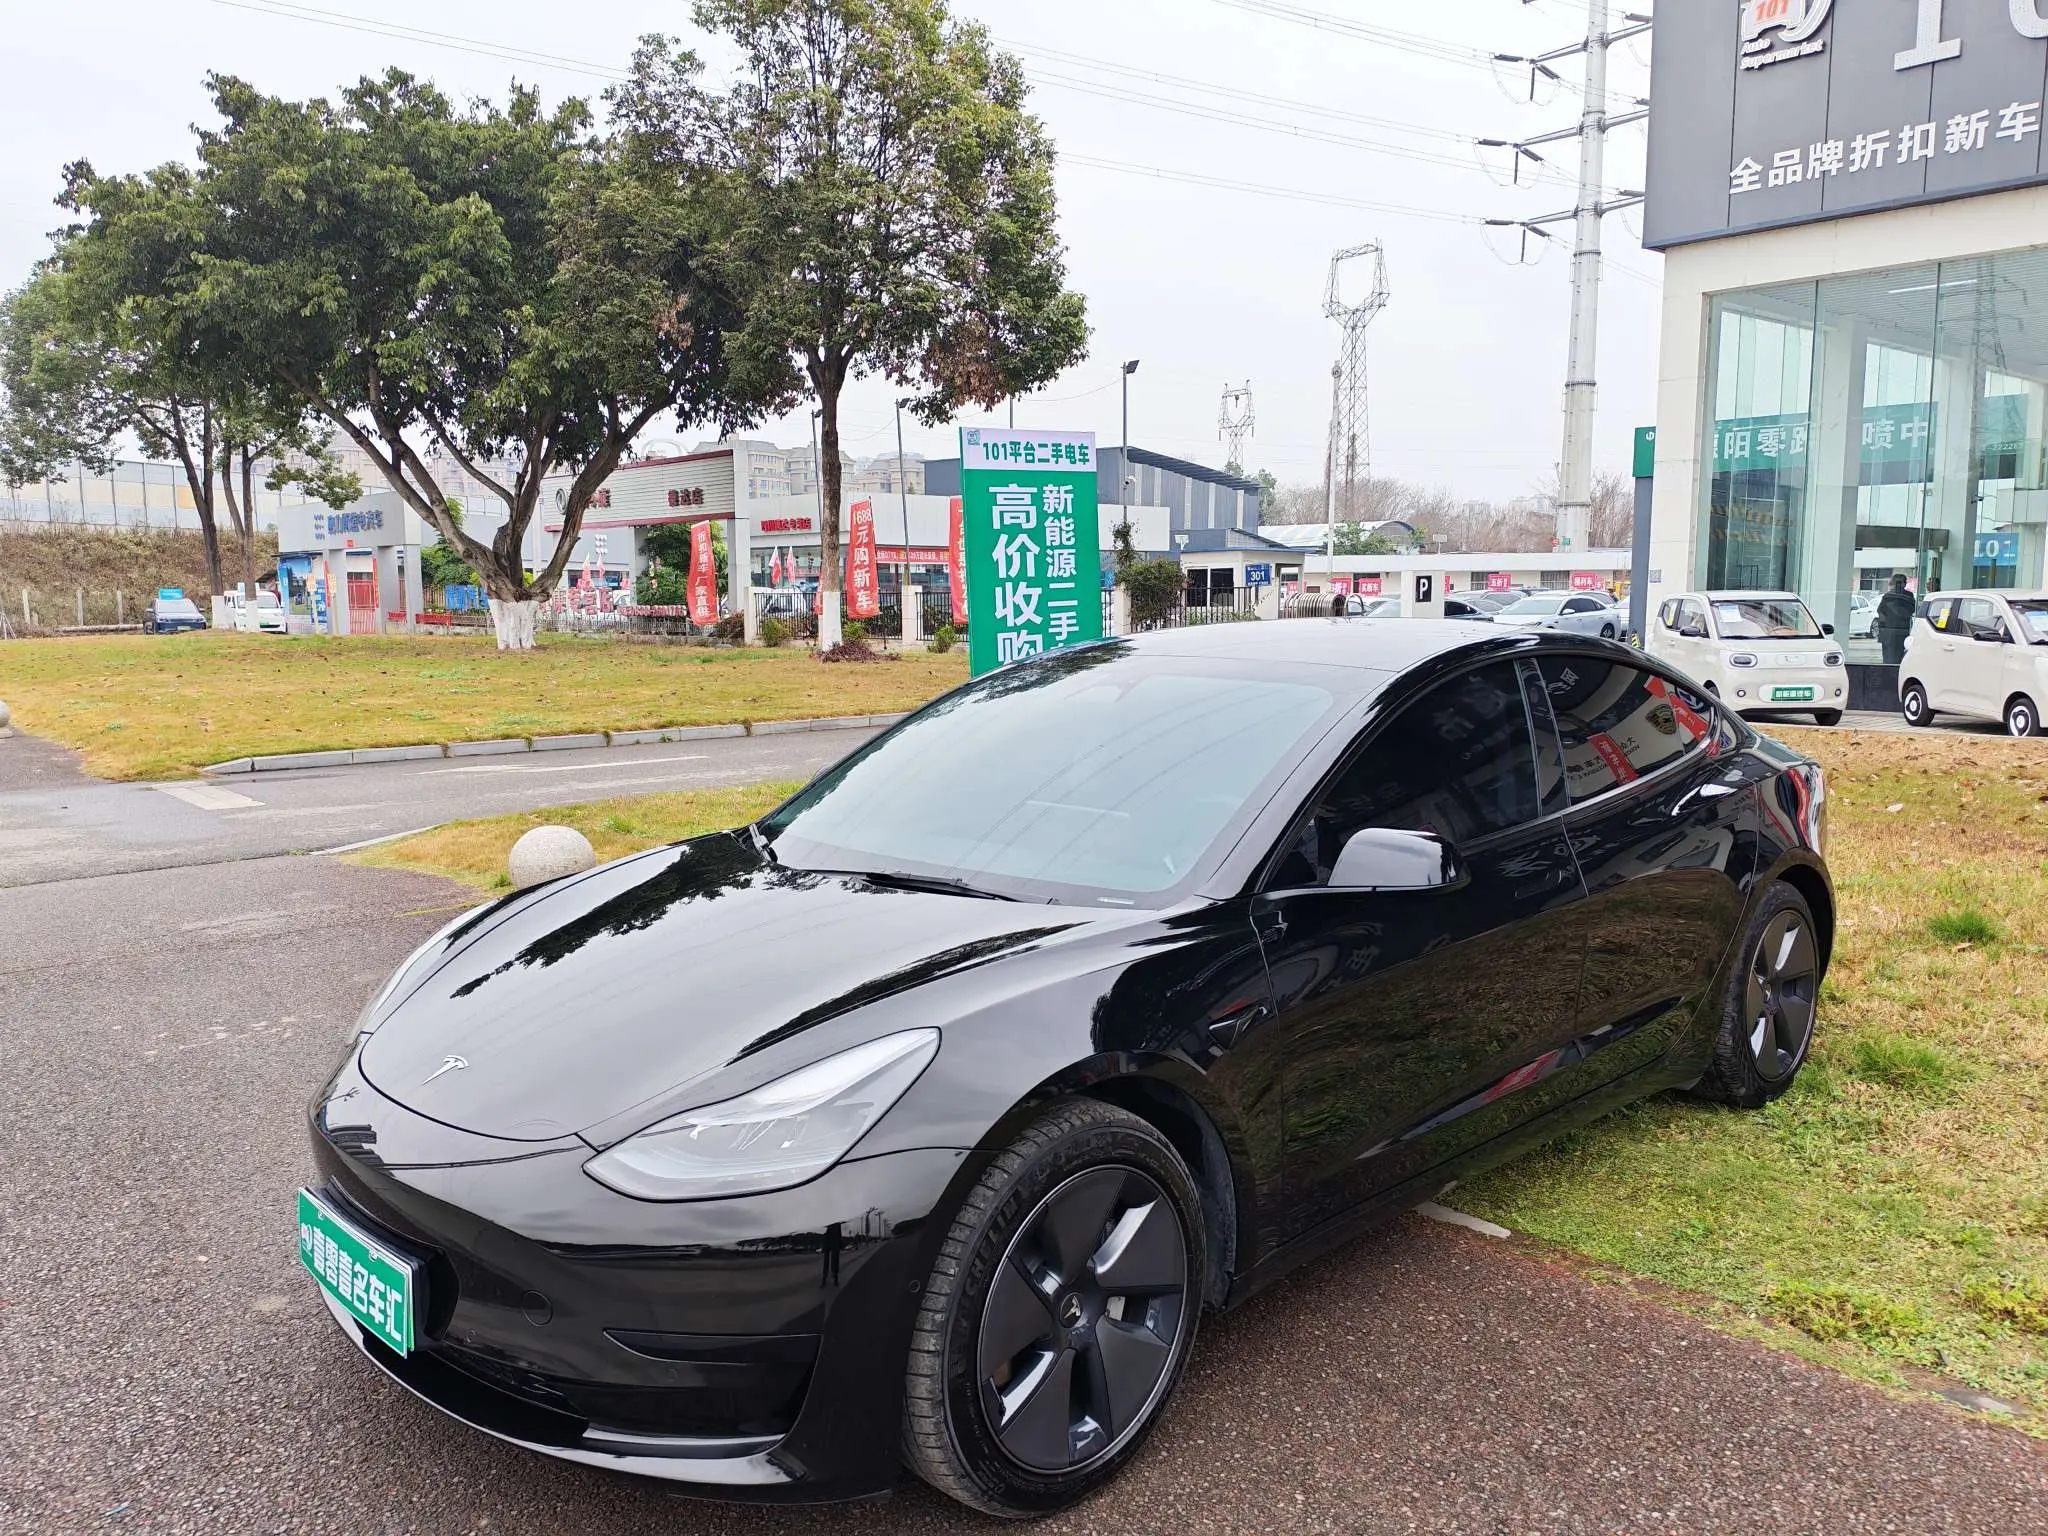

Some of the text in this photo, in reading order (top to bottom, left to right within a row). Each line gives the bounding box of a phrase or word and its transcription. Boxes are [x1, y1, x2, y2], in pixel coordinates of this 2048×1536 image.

[1729, 101, 2041, 194] 全品牌折扣新车
[983, 440, 1090, 466] 101平台二手电车
[988, 483, 1044, 666] 高价收购
[1042, 484, 1080, 650] 新能源二手
[1250, 571, 1265, 581] 301
[1419, 578, 1429, 599] P
